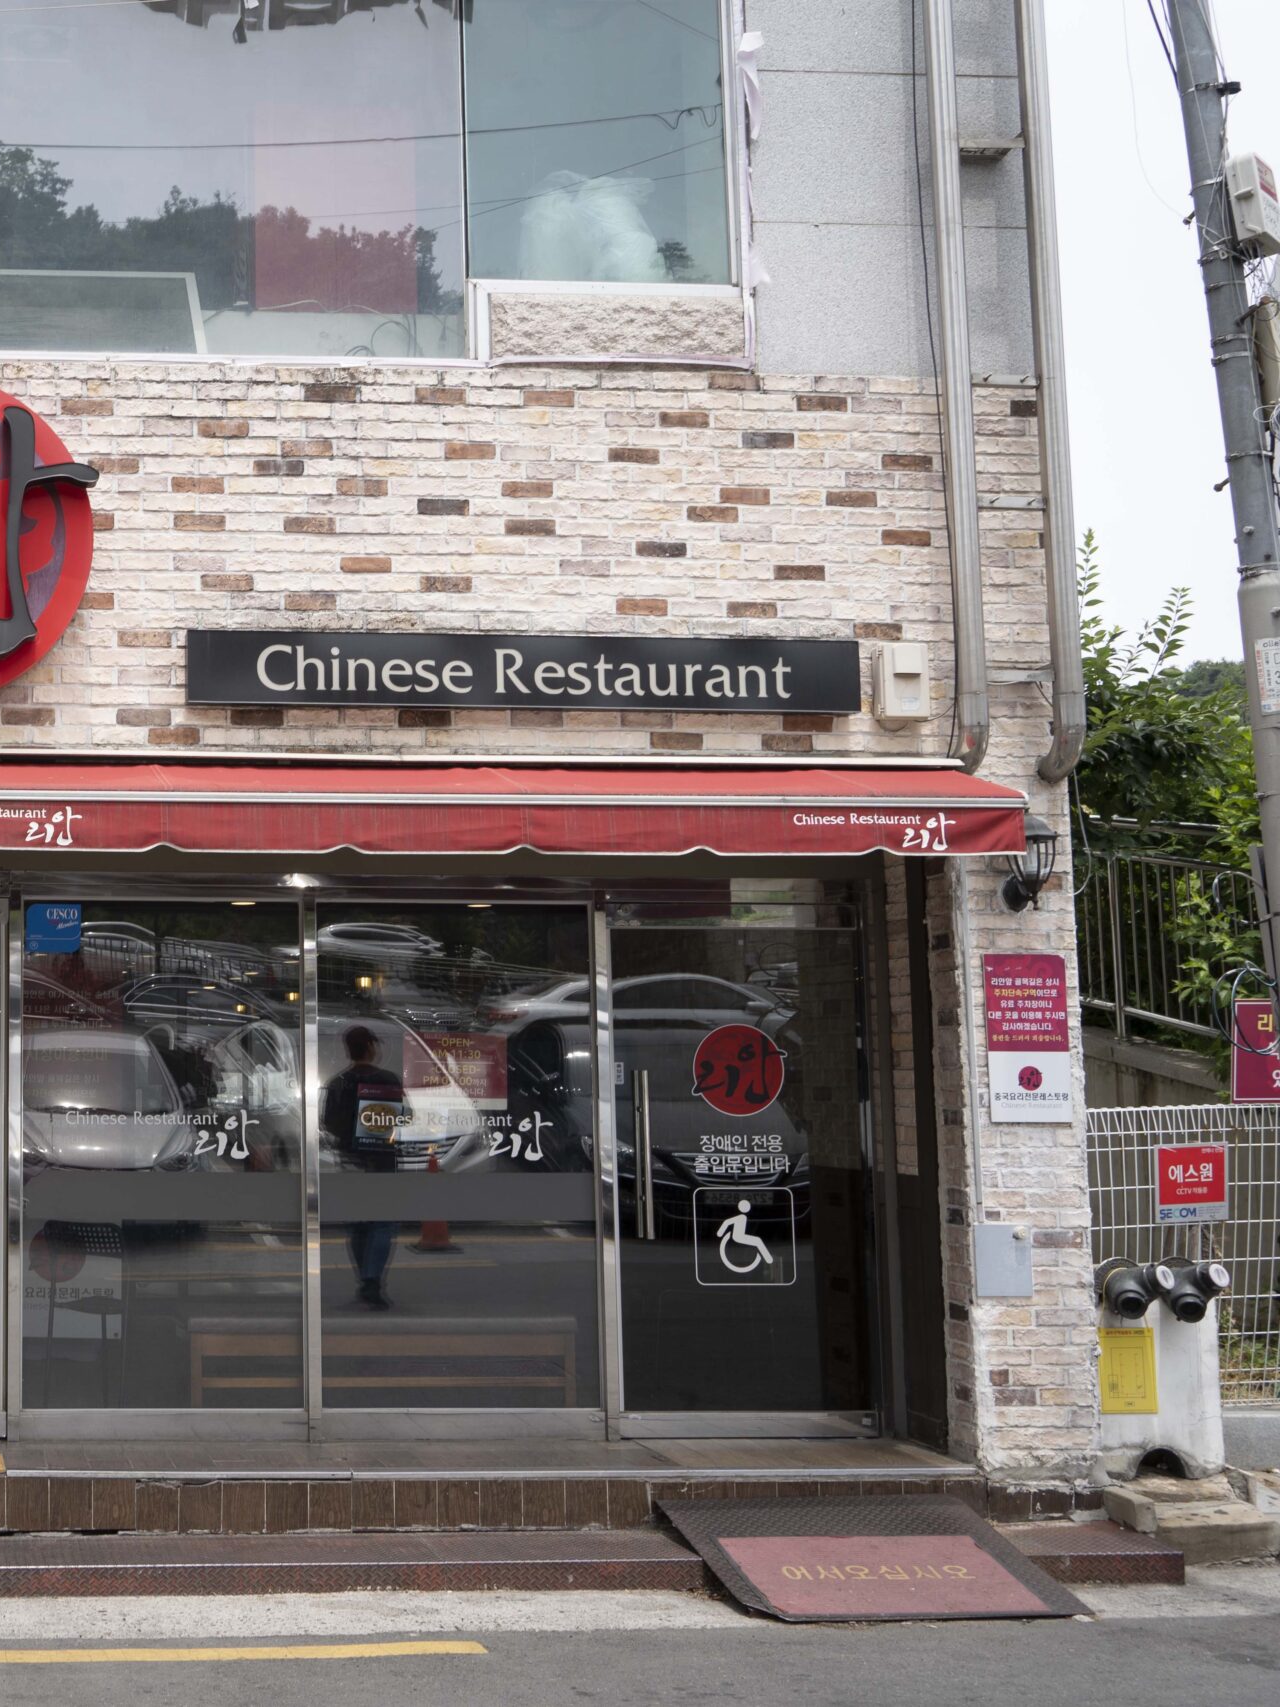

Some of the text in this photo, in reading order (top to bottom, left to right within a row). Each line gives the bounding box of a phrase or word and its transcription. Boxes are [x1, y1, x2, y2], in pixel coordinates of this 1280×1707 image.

[257, 645, 792, 699] Chinese Restaurant
[793, 813, 921, 825] Chinese Restaurant
[46, 908, 78, 920] CESCO
[1046, 978, 1059, 986] 상시
[65, 1111, 218, 1126] Chinese Restaurant
[427, 1112, 512, 1127] Restaurant
[700, 1134, 783, 1152] 장애인 전용
[693, 1155, 790, 1173] 출입문입니다
[1169, 1163, 1213, 1183] 에스원
[1176, 1187, 1192, 1195] CCTV
[1160, 1208, 1197, 1220] SECOM
